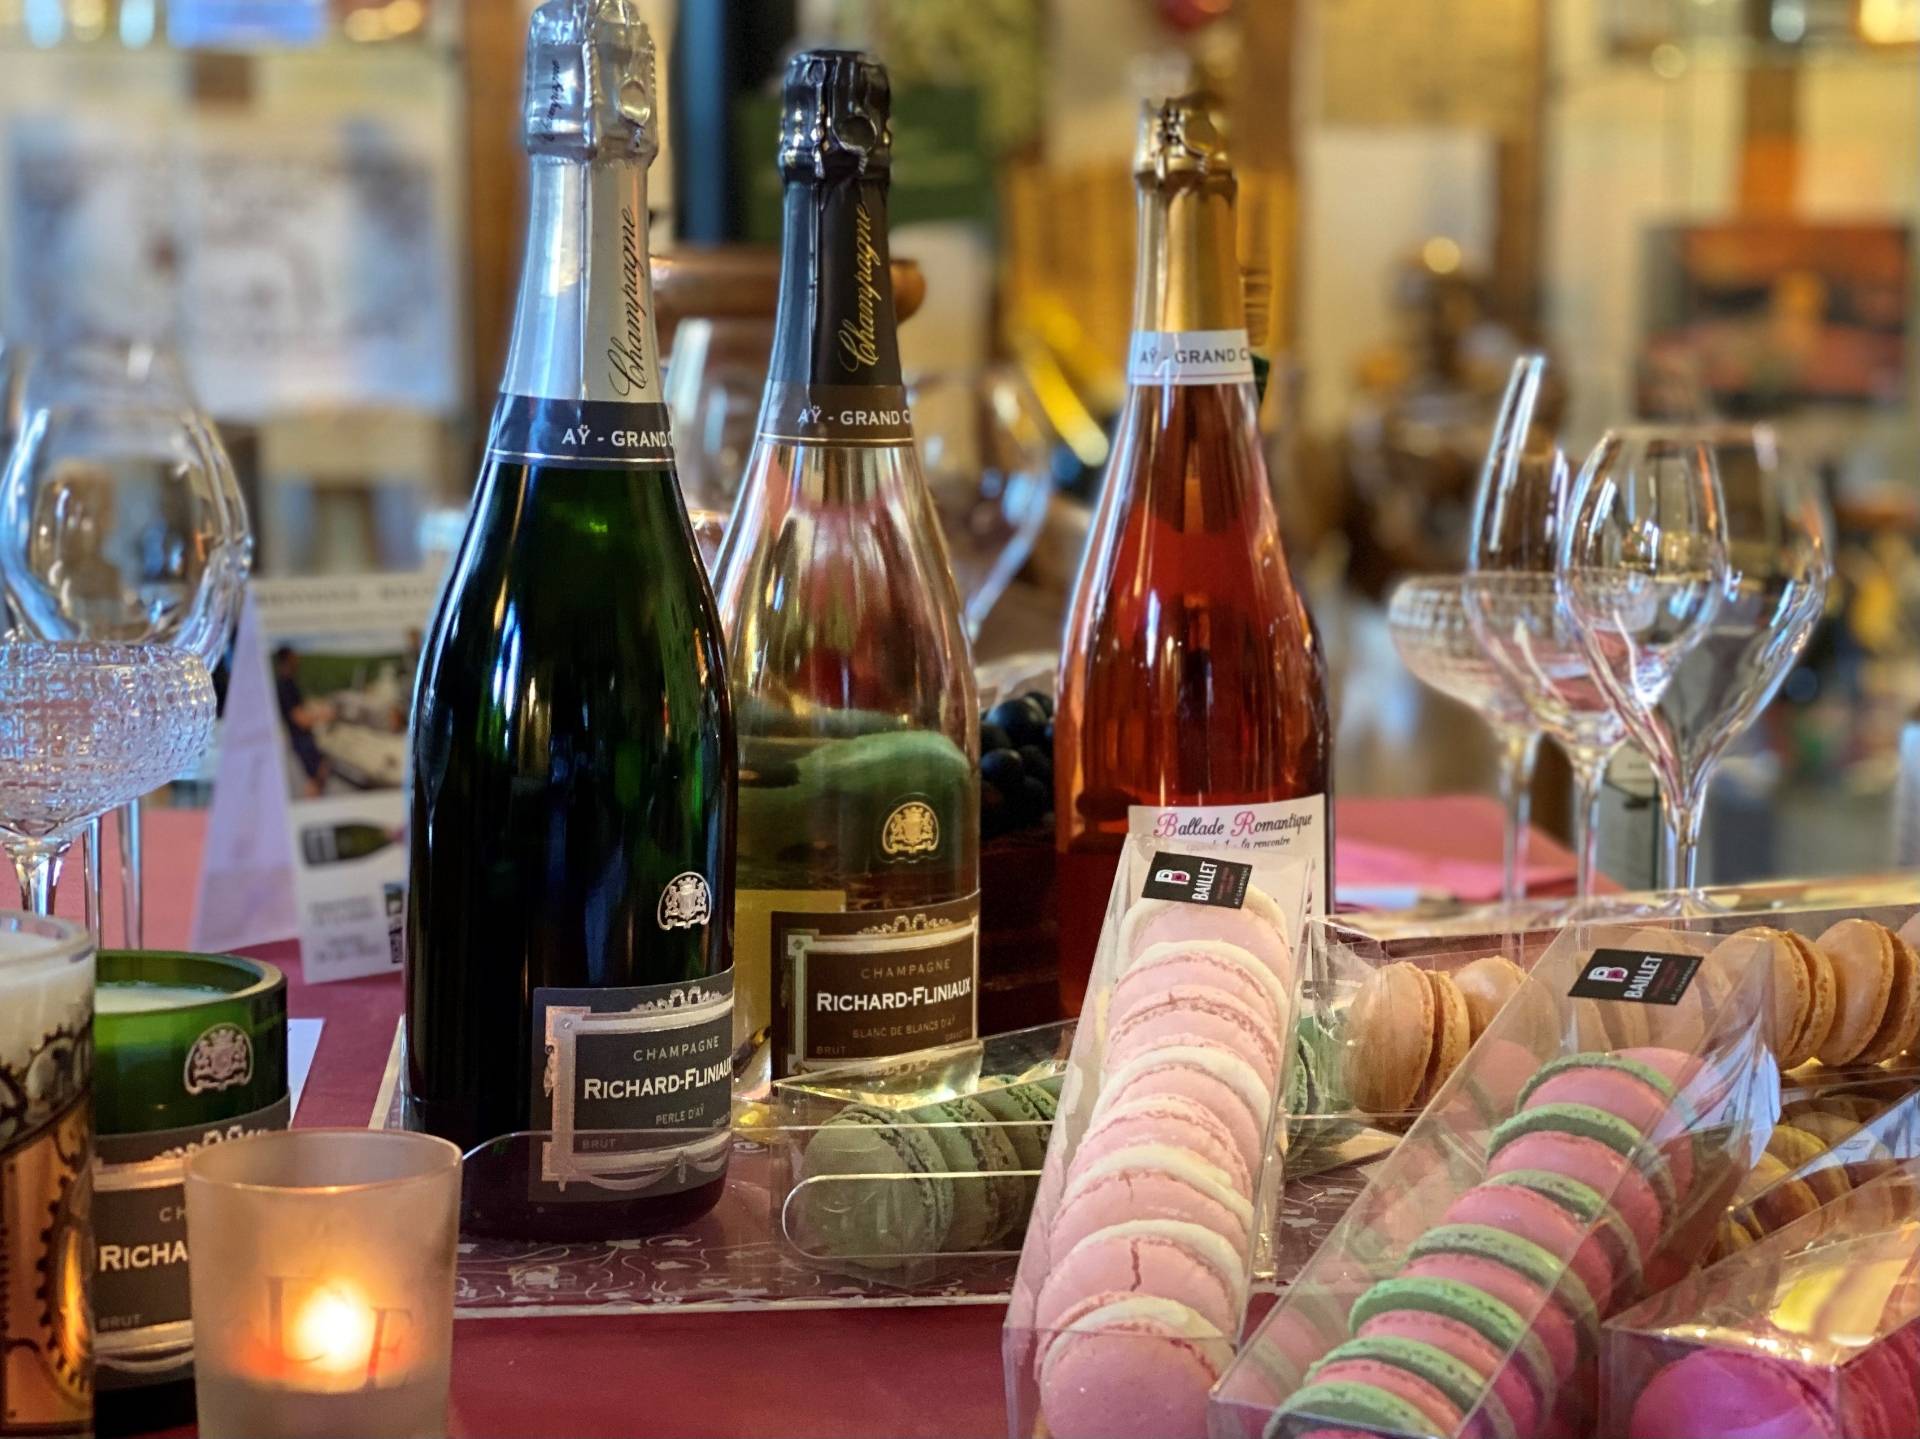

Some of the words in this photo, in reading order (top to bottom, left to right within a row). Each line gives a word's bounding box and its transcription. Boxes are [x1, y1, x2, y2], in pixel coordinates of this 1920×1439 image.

[838, 201, 882, 373] Champagne
[608, 204, 648, 397] Champagne
[1140, 346, 1159, 364] AŸ
[1174, 348, 1236, 364] GRAND
[797, 405, 822, 425] AŸ
[840, 410, 900, 426] GRAND
[561, 424, 591, 446] AŸ
[611, 430, 667, 447] GRAND
[1153, 812, 1225, 837] Ballade
[1230, 810, 1313, 836] Romantique
[1253, 836, 1291, 849] rencontre
[1191, 860, 1218, 901] BAILLET
[860, 958, 951, 979] CHAMPAGNE
[1623, 954, 1664, 999] BAILLET
[816, 976, 972, 1012] RICHARD-FLINIAUX
[852, 1027, 888, 1039] BLANC
[890, 1025, 904, 1037] DE
[906, 1020, 939, 1034] BLANCS
[633, 1035, 720, 1062] CHAMPAGNE
[816, 1045, 847, 1055] BRUT
[655, 1110, 686, 1126] PERLE
[582, 1138, 617, 1149] BRUT
[99, 1240, 188, 1271] RICHA
